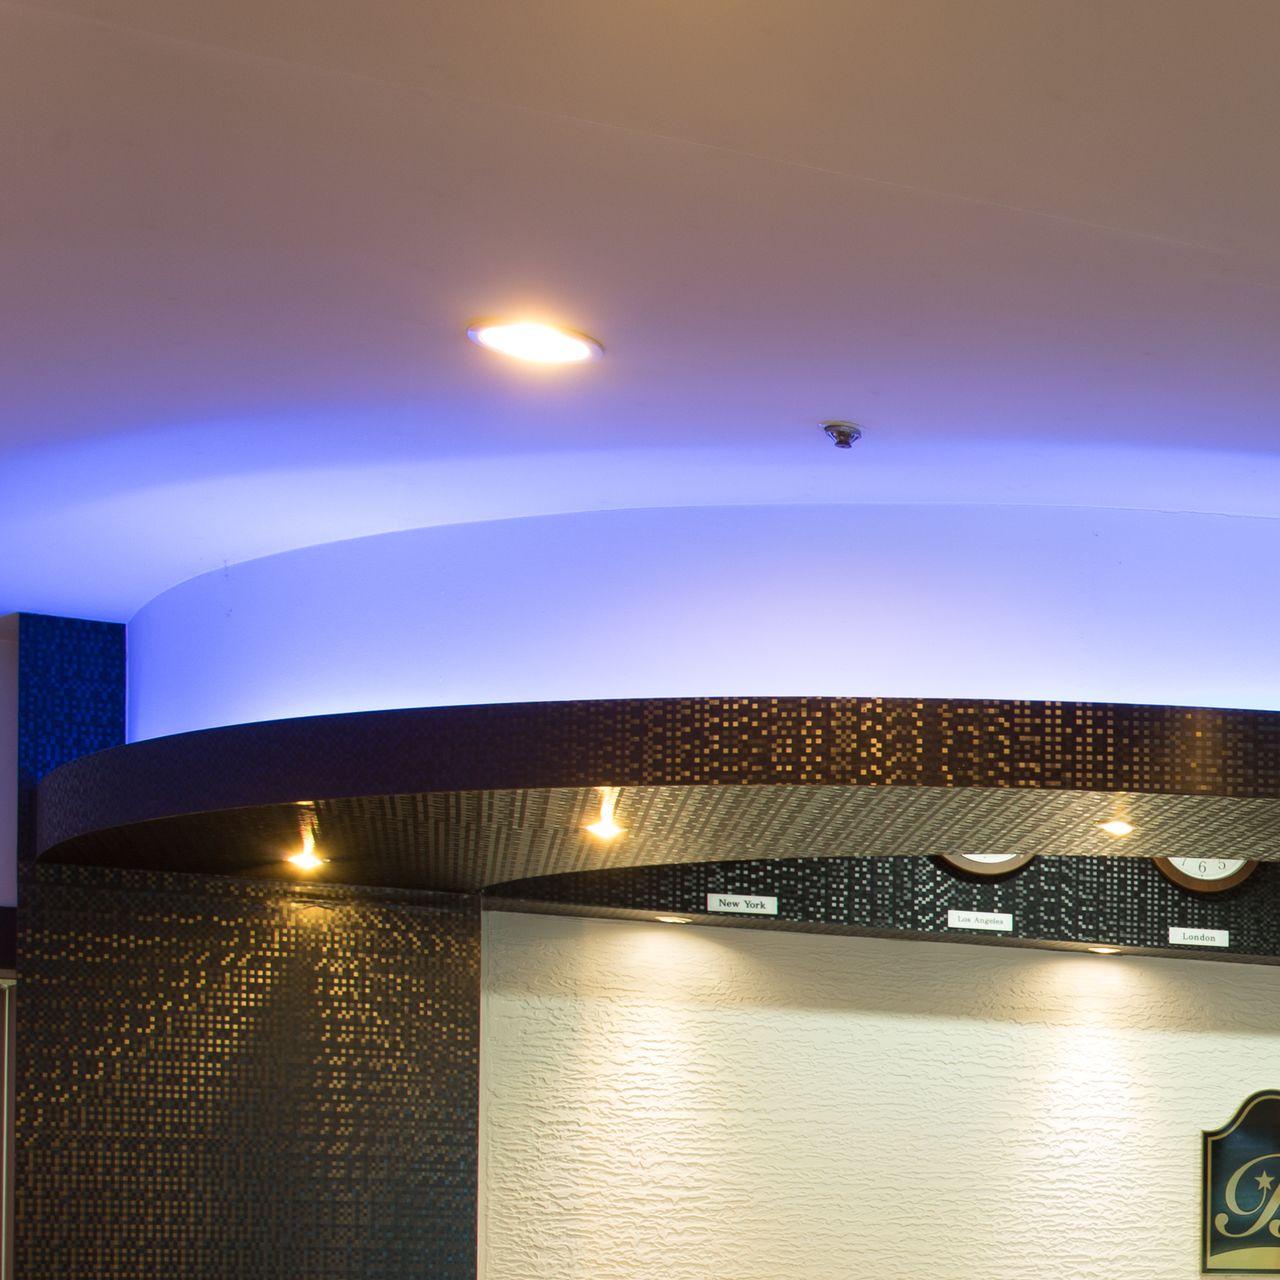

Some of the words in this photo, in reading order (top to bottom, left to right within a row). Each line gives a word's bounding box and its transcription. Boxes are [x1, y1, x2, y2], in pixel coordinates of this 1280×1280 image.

[719, 898, 740, 908] New
[744, 899, 766, 910] York
[957, 915, 971, 923] Los
[975, 916, 1003, 925] Angeles
[1182, 933, 1216, 943] London
